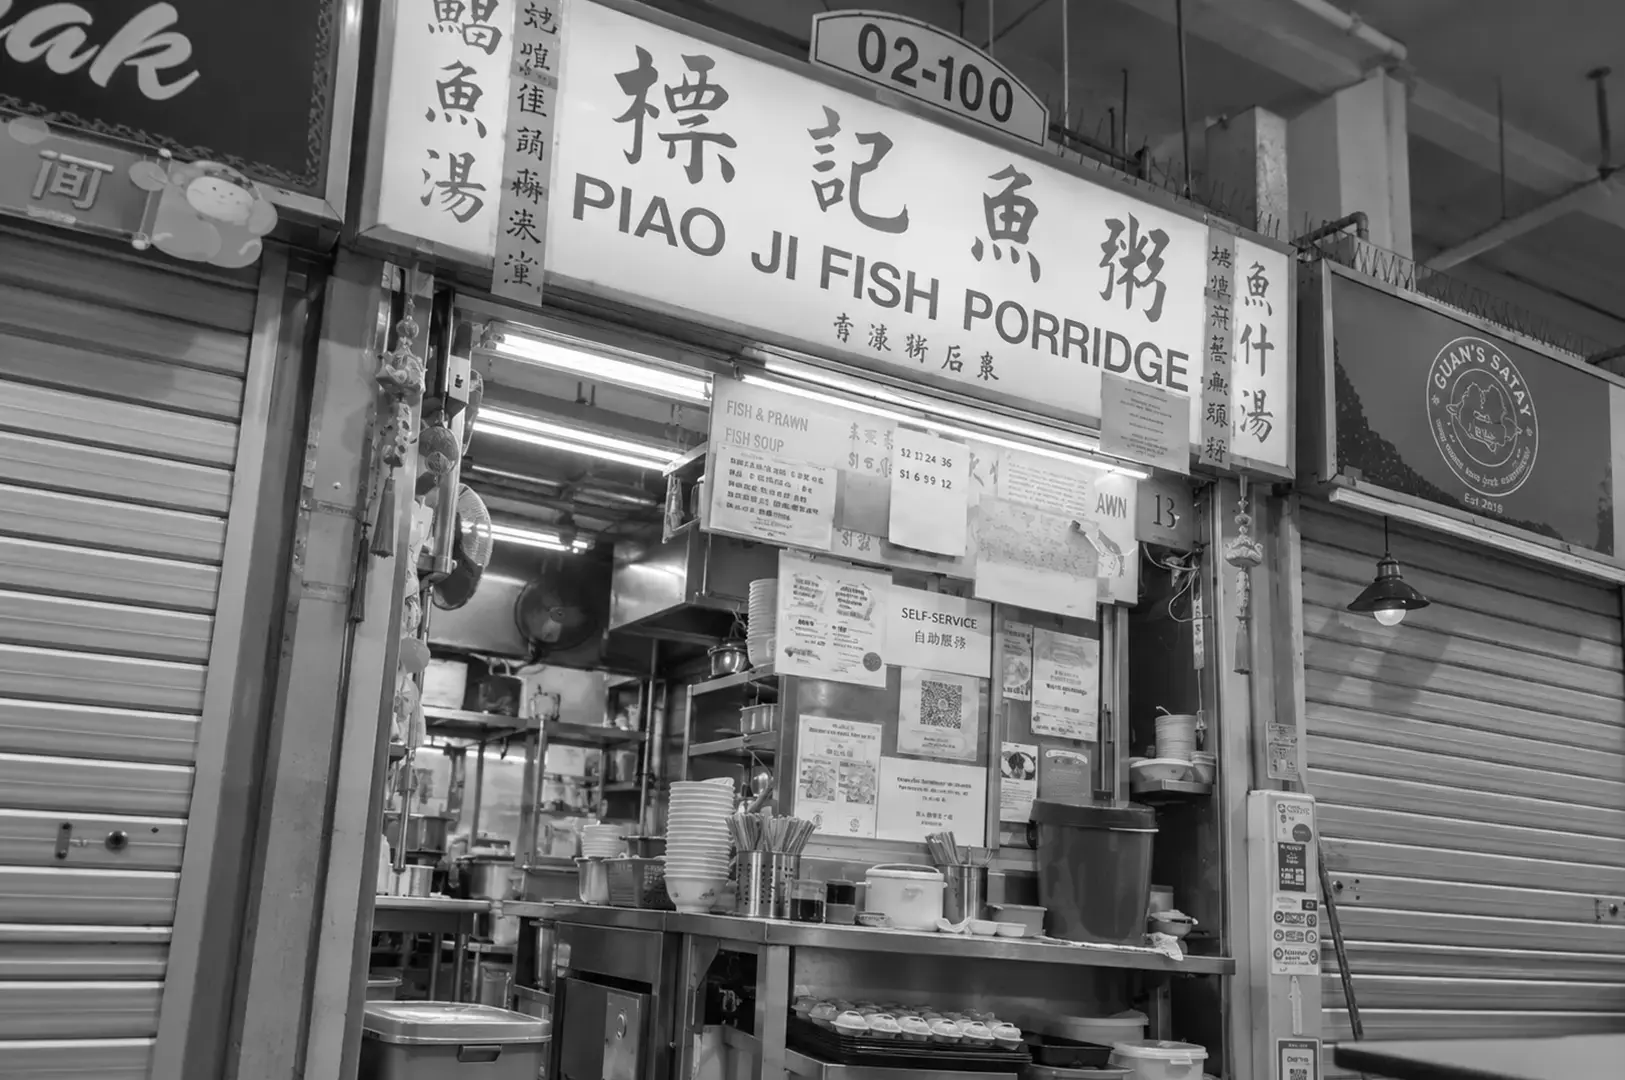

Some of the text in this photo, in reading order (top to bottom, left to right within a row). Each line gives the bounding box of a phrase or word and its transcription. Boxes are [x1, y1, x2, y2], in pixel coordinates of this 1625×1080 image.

[0, 2, 200, 100] ak
[858, 23, 1014, 123] 02-100
[613, 46, 1170, 322] 標記魚粥
[573, 173, 1189, 393] PIAO JI FISH PORRIDGE
[1240, 261, 1275, 443] 魚什湯
[1434, 345, 1532, 416] GUAN'S SATAY
[725, 427, 784, 452] FISH SOUP
[726, 400, 809, 432] FISH & PRAWN
[1152, 494, 1177, 530] 13
[901, 607, 978, 629] SELF-SERVICE
